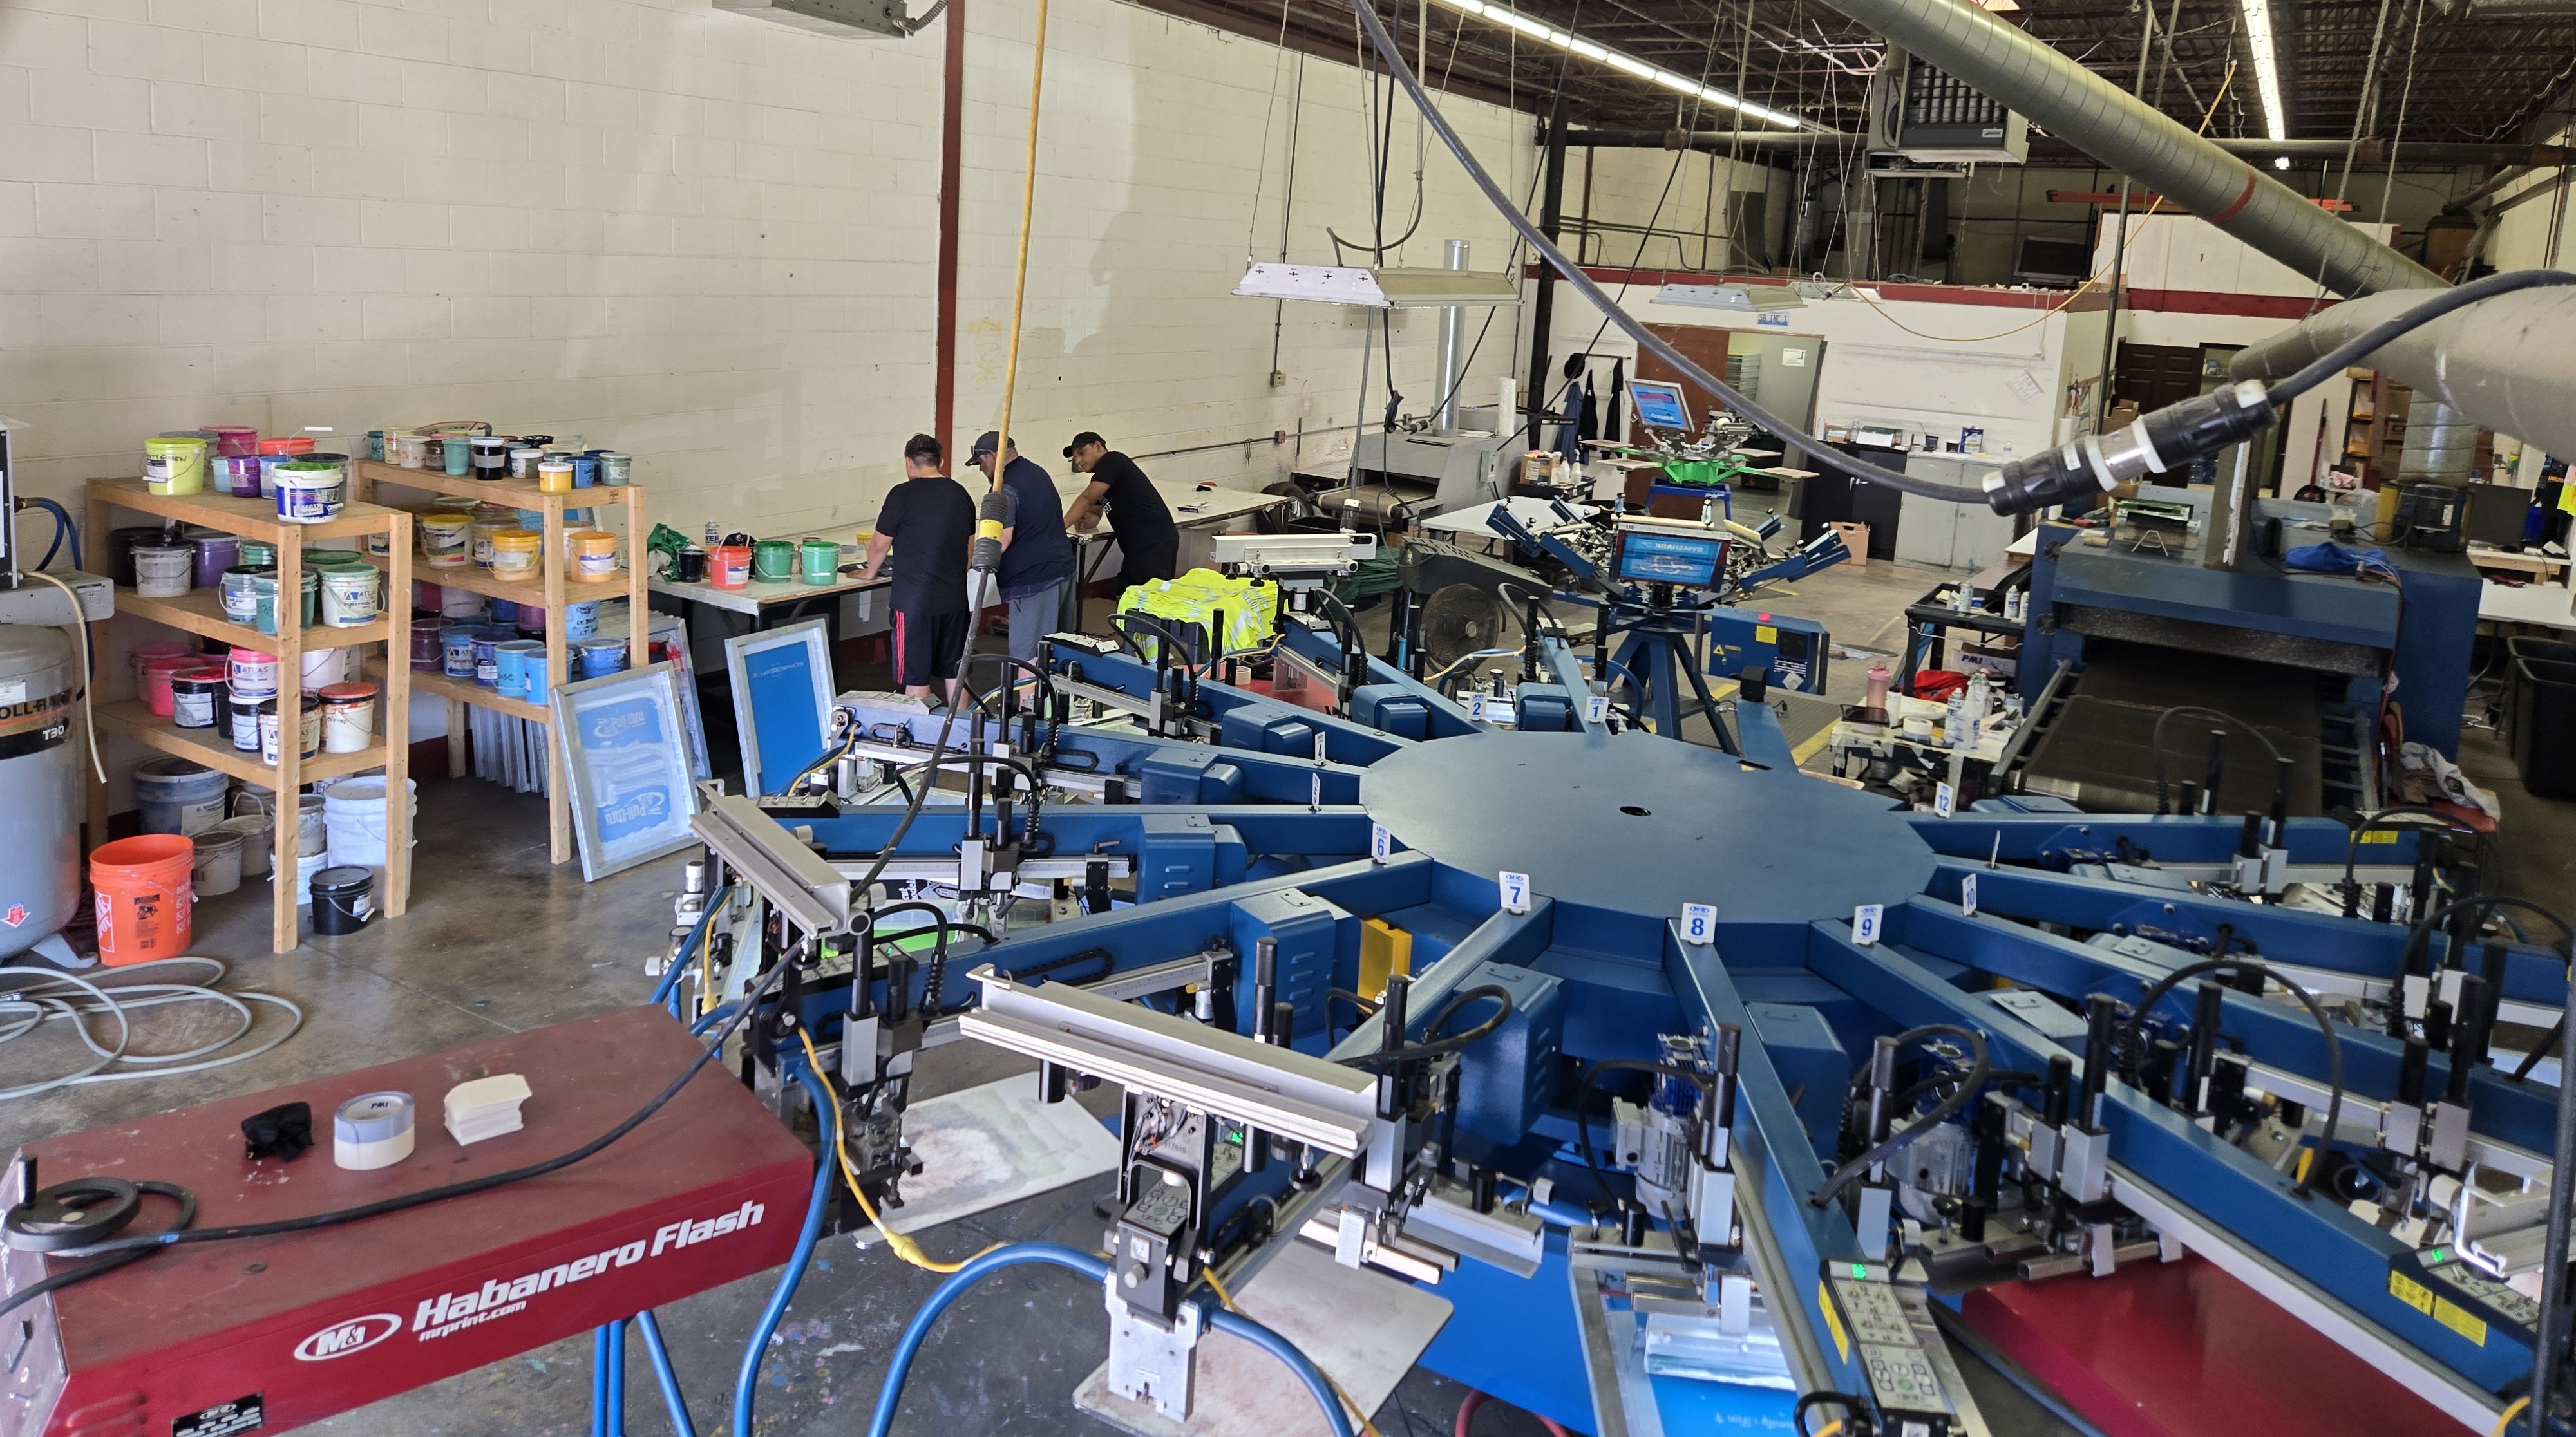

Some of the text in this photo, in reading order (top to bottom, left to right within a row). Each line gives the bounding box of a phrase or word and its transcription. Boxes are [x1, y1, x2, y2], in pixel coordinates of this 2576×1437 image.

[1759, 314, 1767, 322] SB
[1770, 314, 1781, 323] INC
[1962, 654, 2009, 670] PMI TAPE
[1472, 702, 1481, 715] 2
[1592, 705, 1600, 718] 1
[43, 725, 64, 740] T30
[1318, 743, 1323, 759] 4
[1313, 787, 1318, 803] 5
[1938, 794, 1950, 812] 12
[1377, 838, 1385, 856] 6
[1509, 885, 1521, 905] 7
[1966, 887, 1975, 908] 10
[1690, 917, 1705, 936] 8
[1861, 917, 1873, 937] 9
[412, 1239, 647, 1333] Habanero
[650, 1199, 765, 1257] Flash
[418, 1299, 527, 1344] mrprint.com
